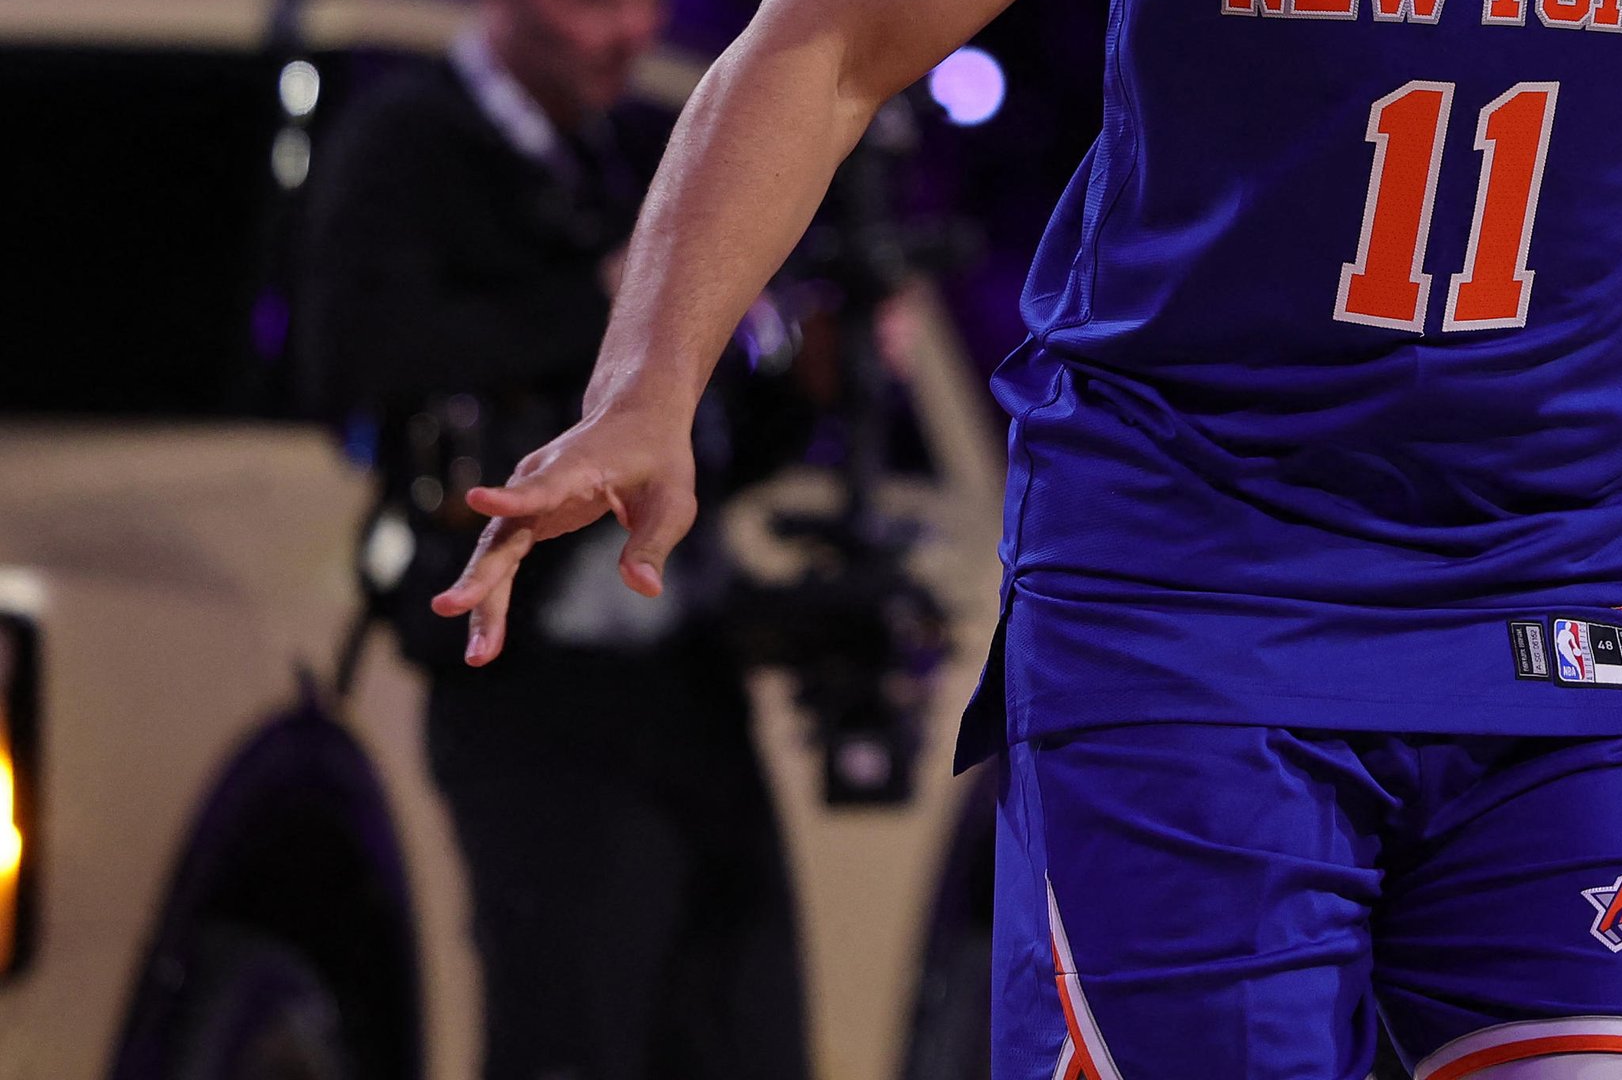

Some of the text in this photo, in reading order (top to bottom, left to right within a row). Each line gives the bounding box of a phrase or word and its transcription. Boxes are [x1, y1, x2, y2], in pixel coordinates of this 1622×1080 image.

[1333, 80, 1560, 332] 11
[1597, 640, 1614, 651] 48
[1563, 666, 1577, 677] NBA
